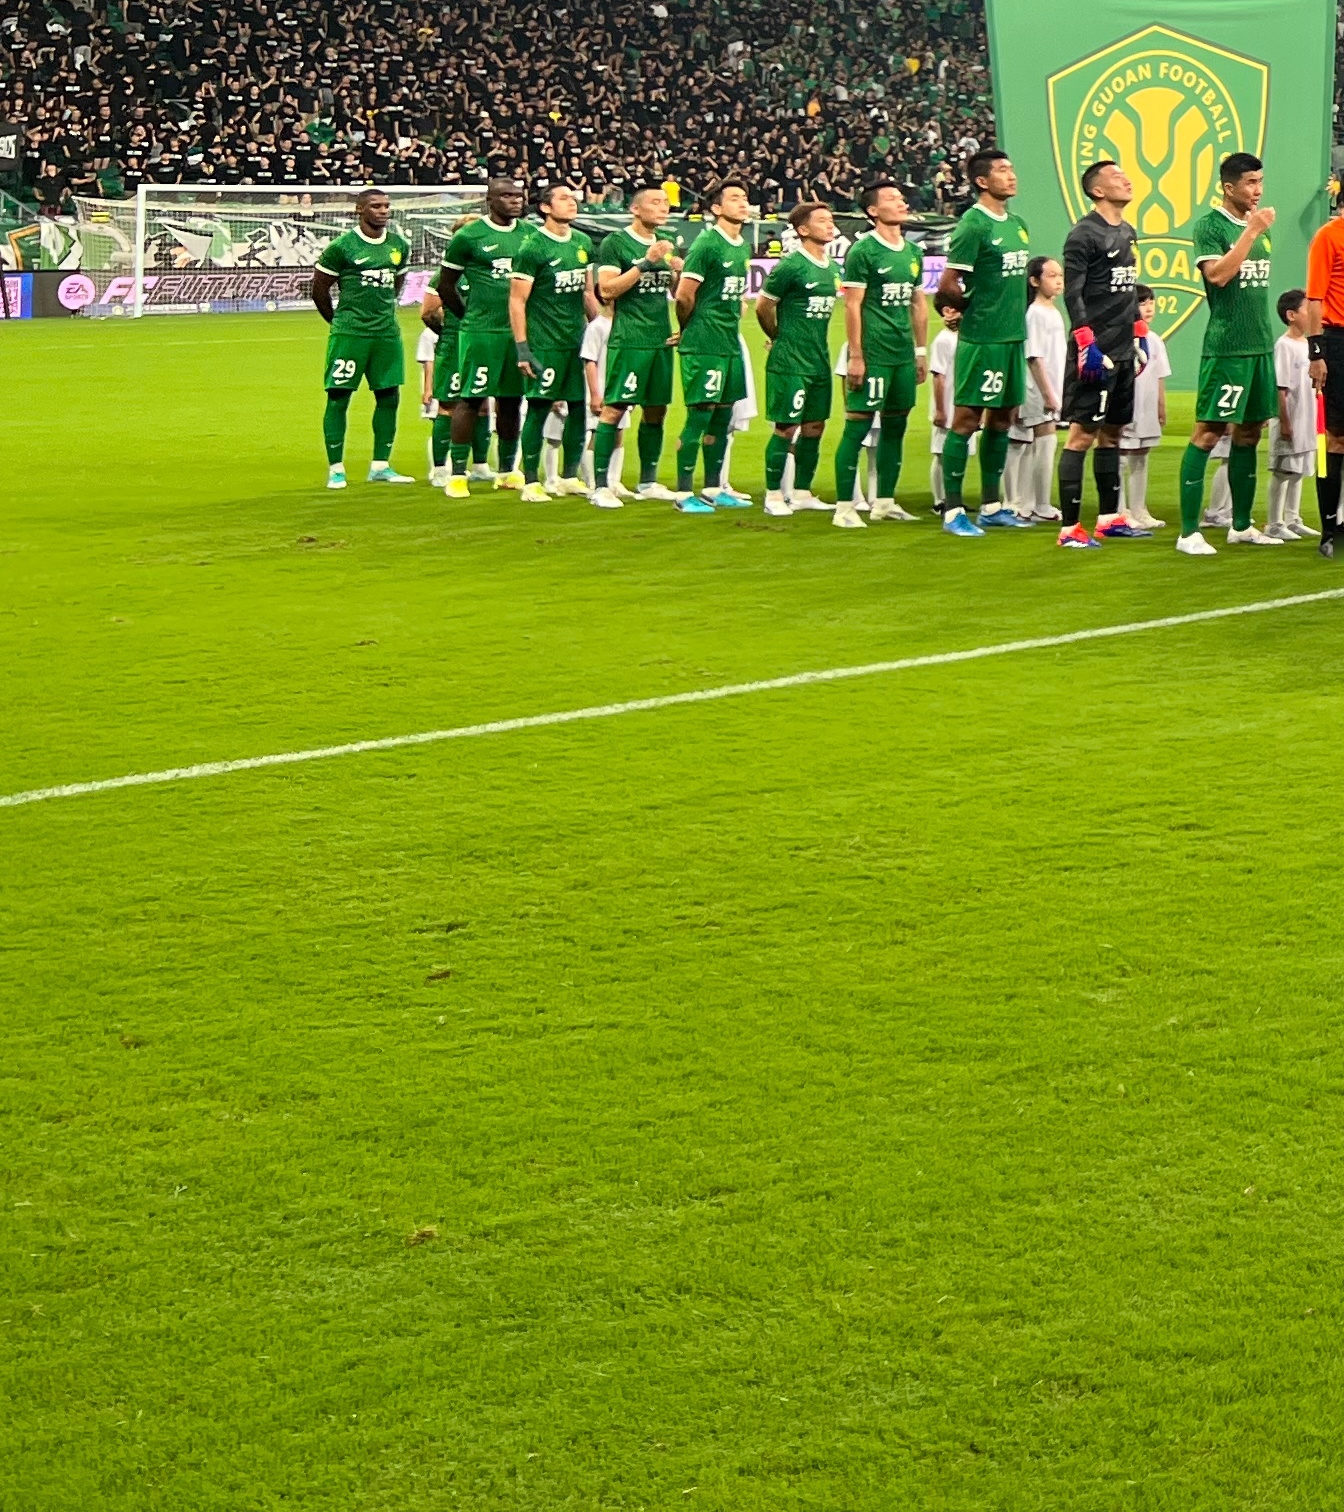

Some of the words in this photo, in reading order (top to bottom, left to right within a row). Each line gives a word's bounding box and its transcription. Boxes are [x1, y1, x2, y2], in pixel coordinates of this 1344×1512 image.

[1092, 63, 1151, 117] GUOAN
[1159, 62, 1231, 143] FOOTBALL
[1239, 259, 1271, 279] 京东
[1157, 295, 1178, 314] 92
[332, 359, 356, 379] 29
[474, 366, 488, 386] 5
[541, 368, 556, 387] 9
[450, 372, 461, 391] 8
[624, 371, 638, 392] 4
[704, 369, 722, 391] 21
[867, 377, 884, 399] 11
[980, 369, 1003, 393] 26
[793, 389, 806, 410] 6
[1099, 390, 1108, 413] 1
[1217, 385, 1244, 409] 27
